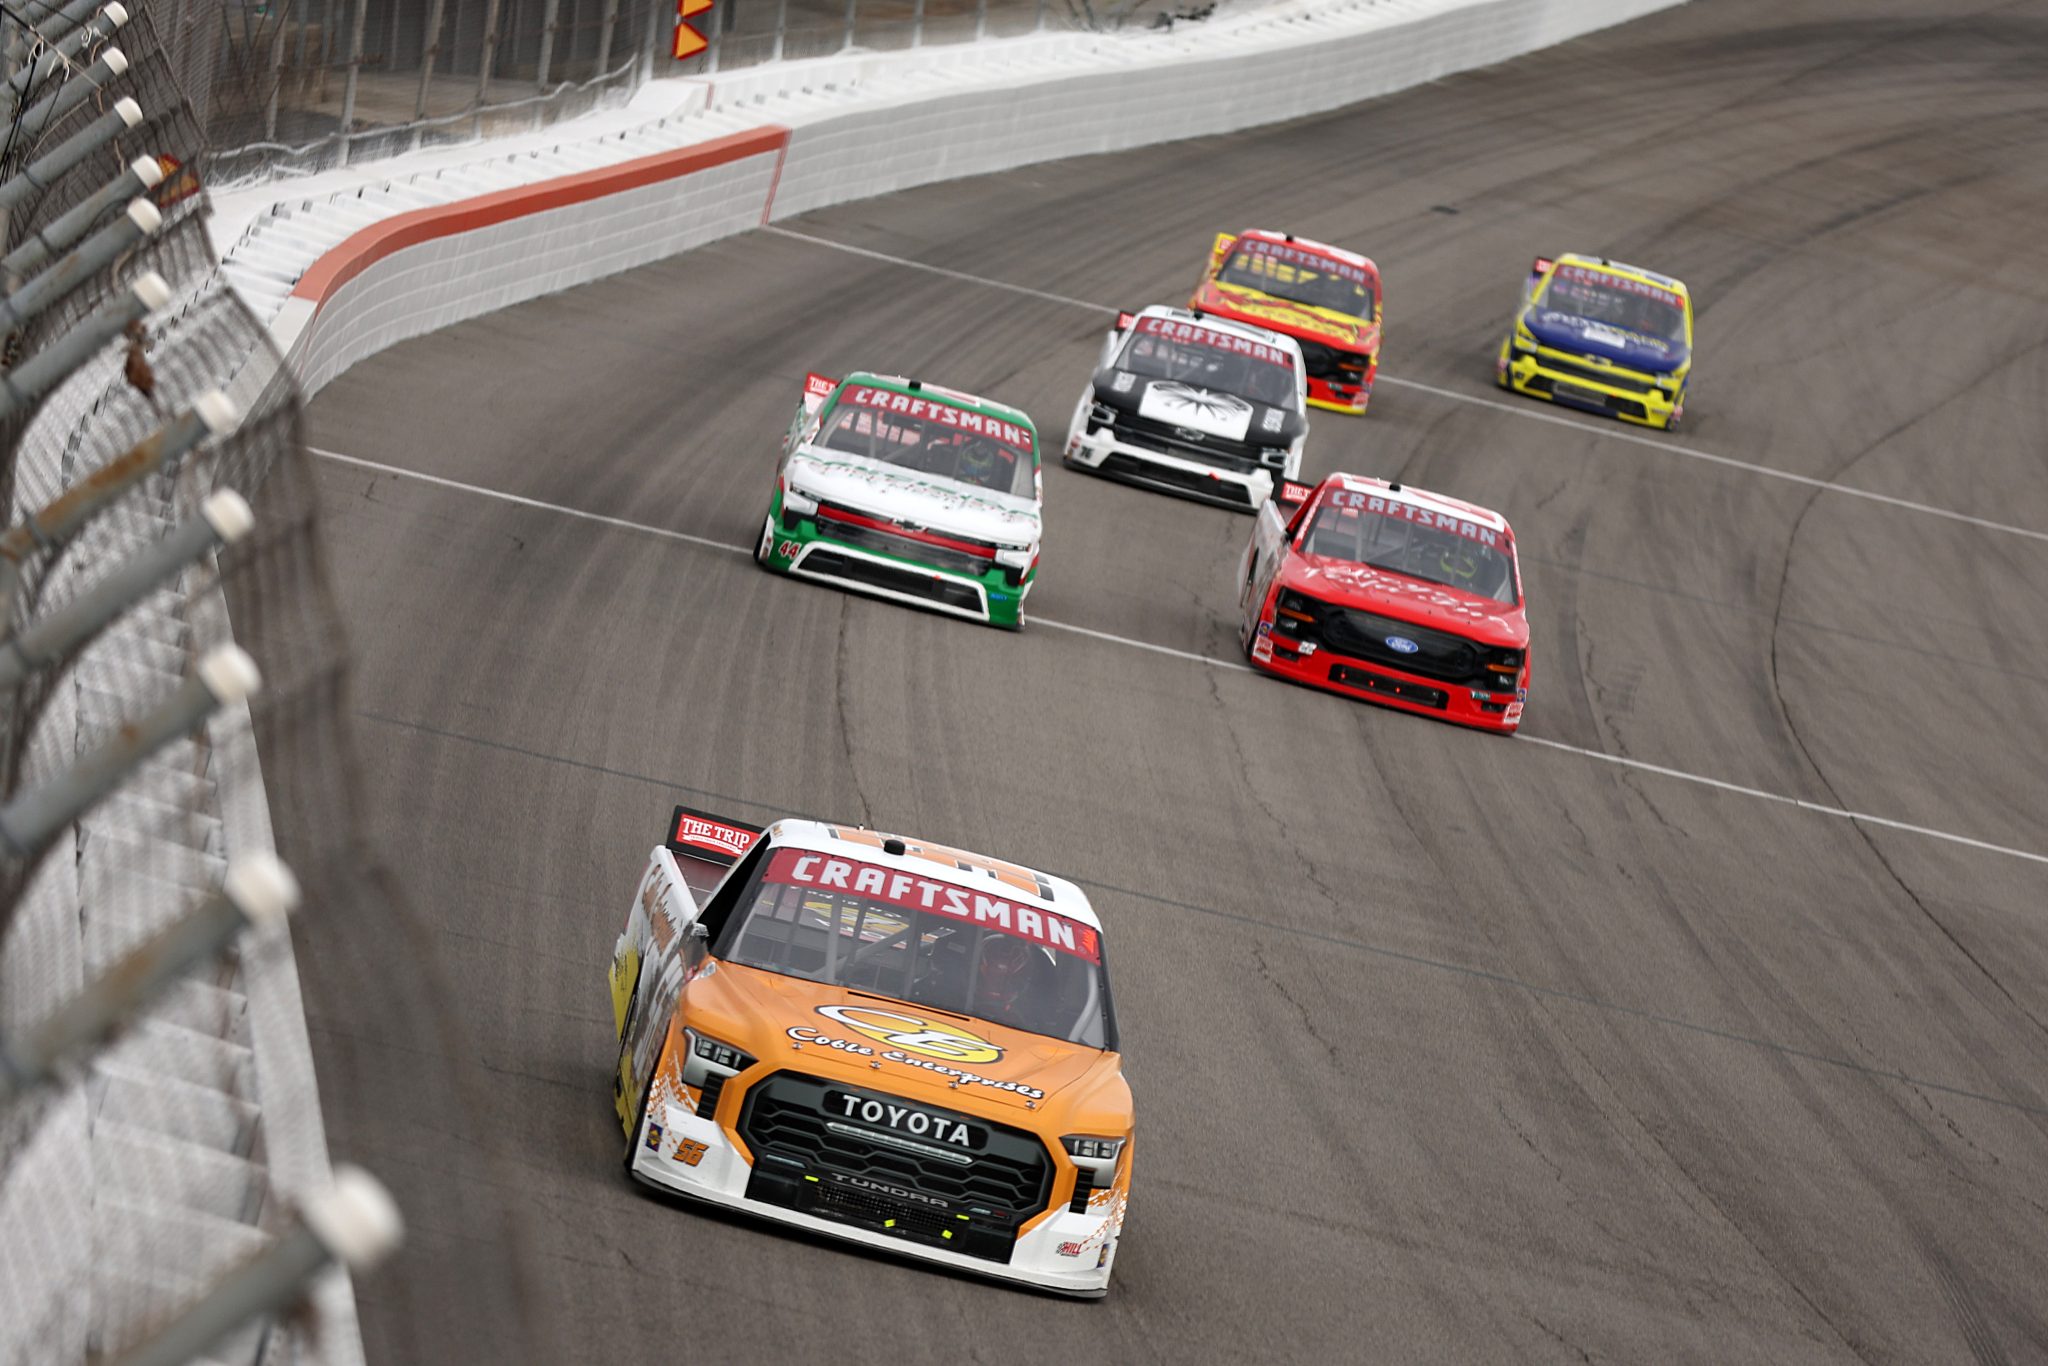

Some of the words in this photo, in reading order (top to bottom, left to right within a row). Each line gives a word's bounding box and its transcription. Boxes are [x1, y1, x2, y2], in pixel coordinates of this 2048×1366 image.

[1245, 240, 1365, 282] CRAFTSMAN
[1562, 267, 1677, 305] CRAFTSMAN
[1147, 319, 1284, 364] CRAFTSMAN
[855, 388, 1020, 445] CRAFTSMAN
[1332, 490, 1499, 546] CRAFTSMAN
[779, 540, 801, 559] 44
[682, 817, 713, 837] THE
[714, 825, 750, 849] TRIP
[791, 855, 1076, 950] CRAFTSMAN
[787, 1026, 874, 1057] Coble
[880, 1050, 1045, 1100] Enterprises
[843, 1094, 970, 1147] TOYOTA
[672, 1137, 709, 1167] 56
[831, 1172, 949, 1208] TUNDRA
